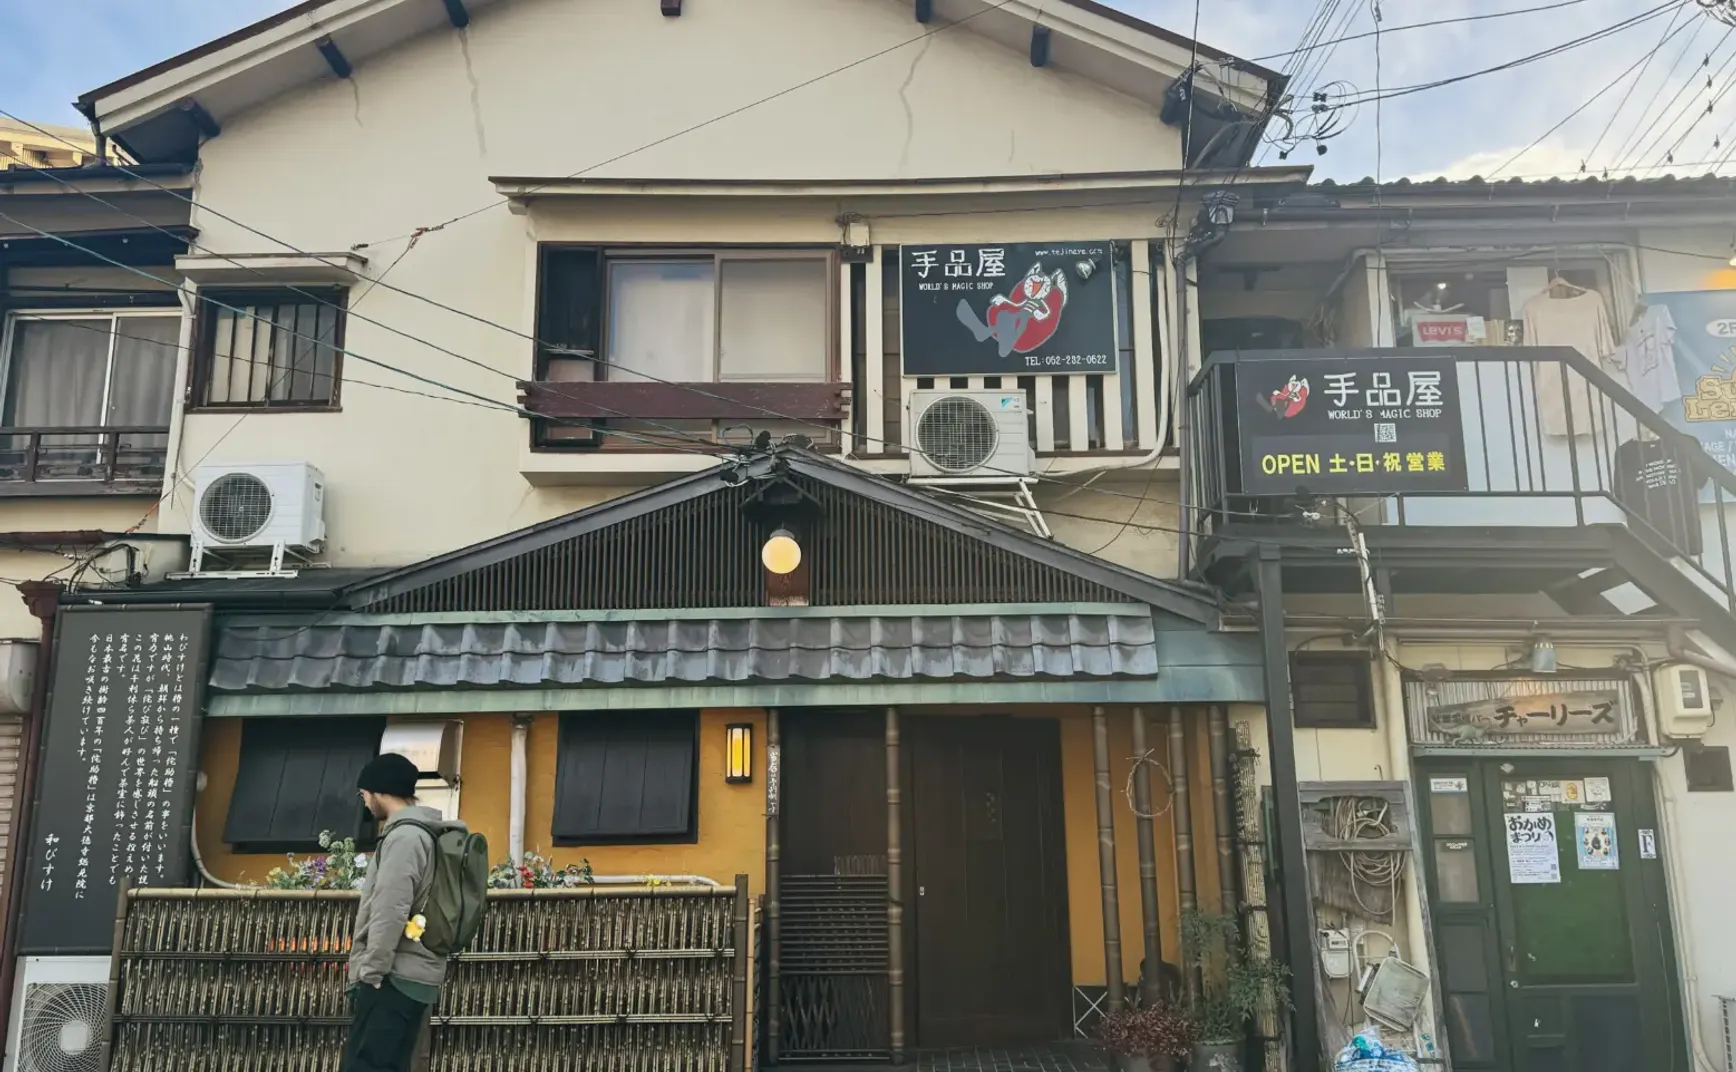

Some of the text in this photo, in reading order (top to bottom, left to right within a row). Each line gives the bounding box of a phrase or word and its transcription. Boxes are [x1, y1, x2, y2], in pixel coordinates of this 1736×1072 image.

[911, 248, 1005, 278] 手品屋
[919, 282, 993, 291] WORLD'S MAGIC SHOP
[1324, 371, 1443, 407] 手品屋
[1328, 409, 1373, 419] WORLD'S
[1416, 408, 1442, 418] SHOP
[1261, 454, 1320, 474] OPEN
[1494, 700, 1614, 728] チャーリーズ
[1509, 815, 1552, 832] おかめ
[1511, 832, 1541, 844] まつり
[40, 833, 60, 891] 和びすけ
